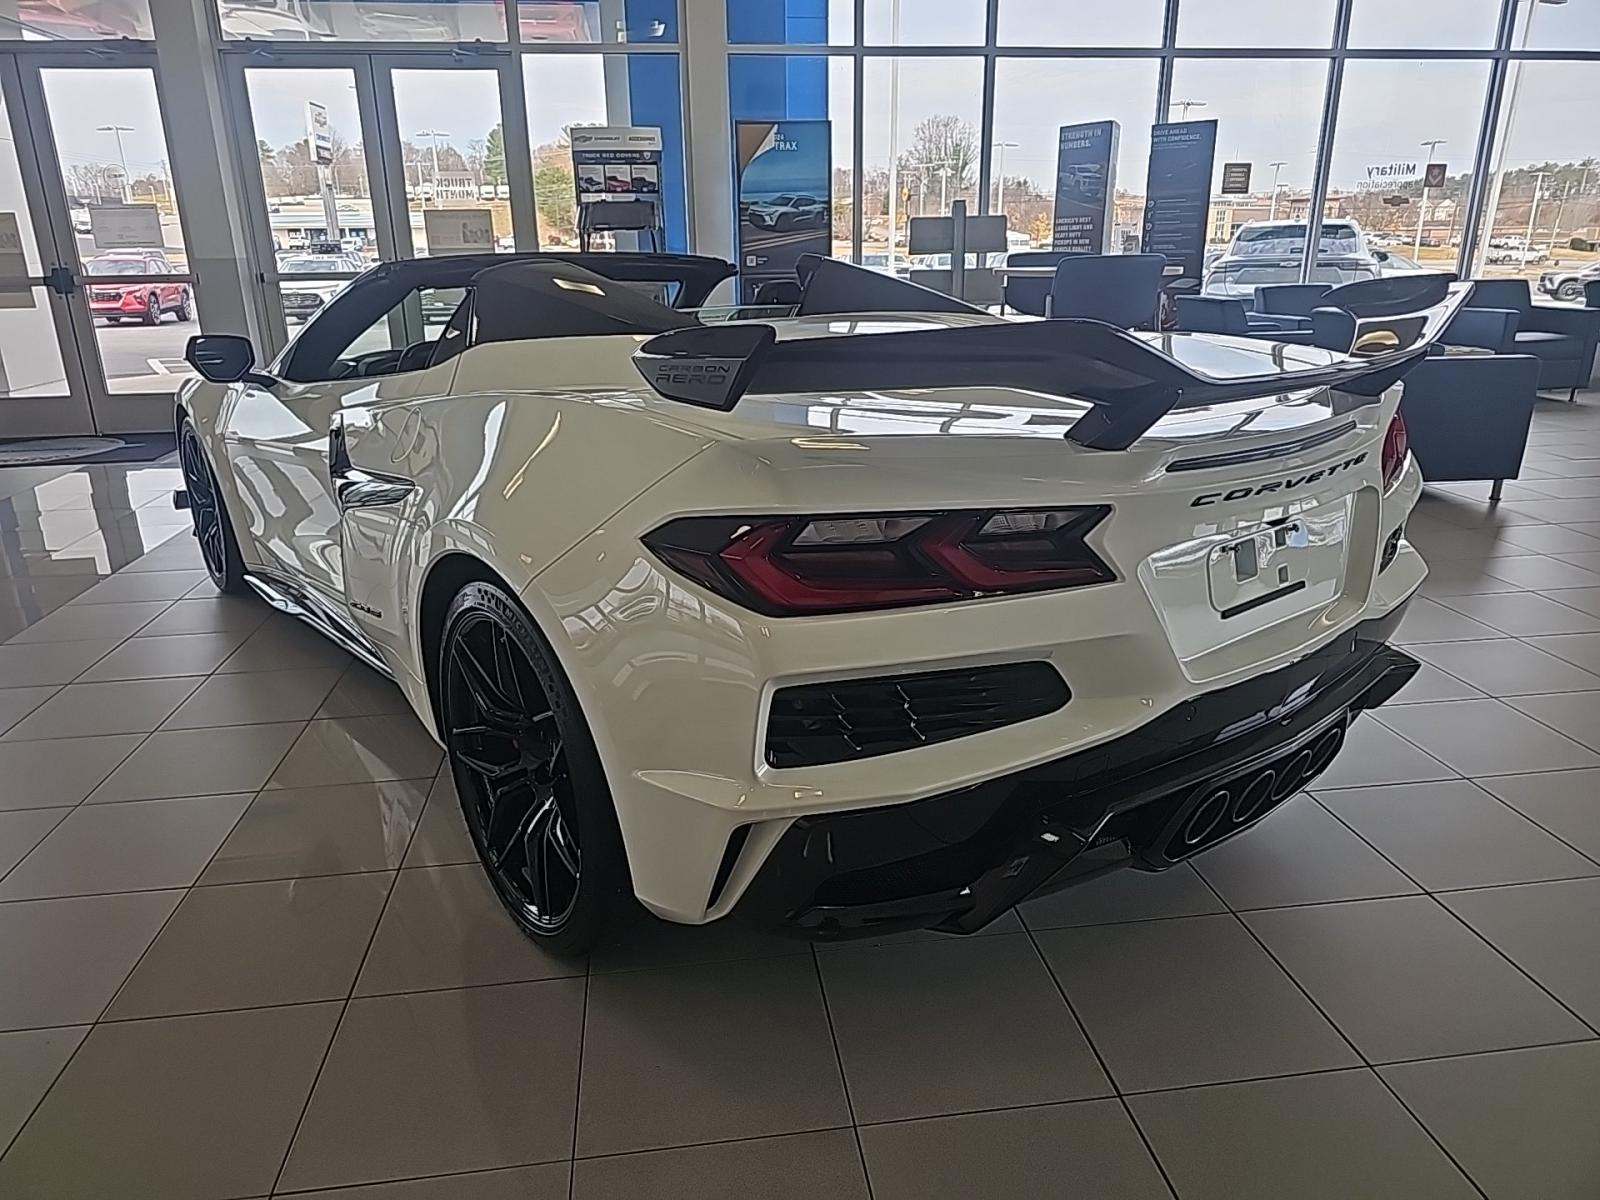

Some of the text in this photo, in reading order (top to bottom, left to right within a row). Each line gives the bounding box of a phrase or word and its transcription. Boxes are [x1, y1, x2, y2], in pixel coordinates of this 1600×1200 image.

[775, 141, 797, 150] TRAX
[658, 364, 731, 373] CARBON
[655, 374, 726, 385] AERO
[1190, 450, 1369, 507] CORVETTE
